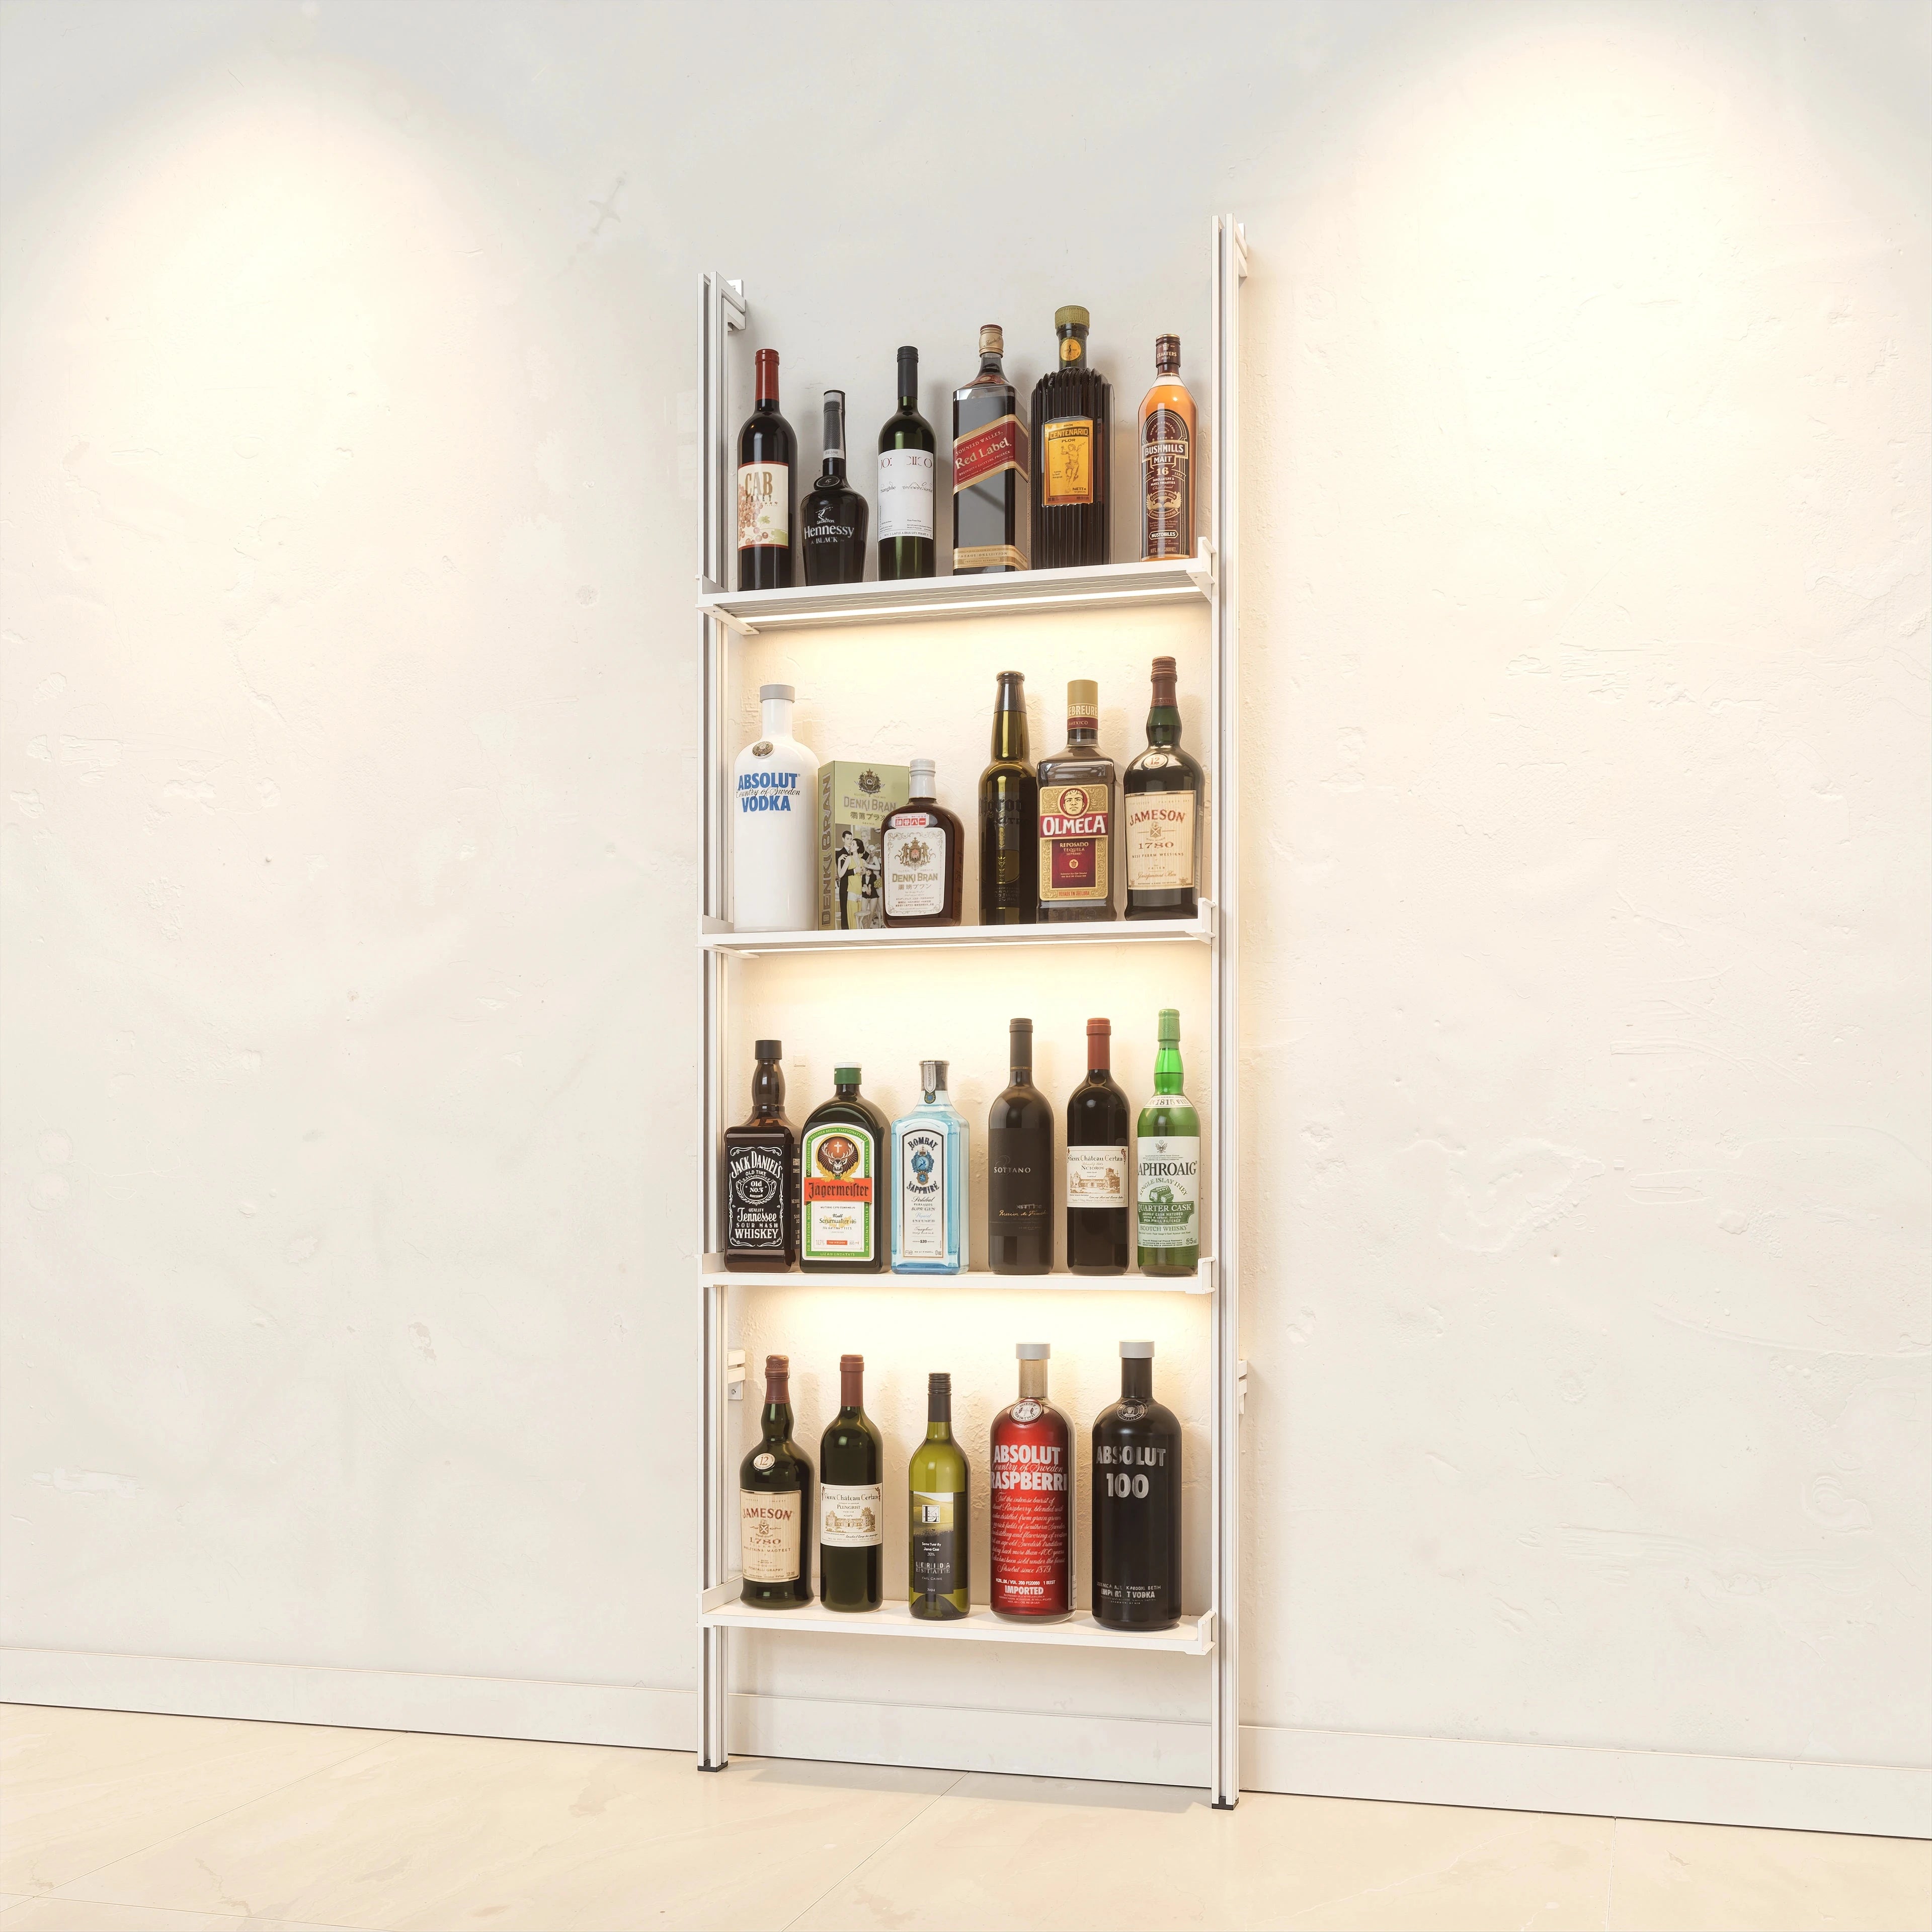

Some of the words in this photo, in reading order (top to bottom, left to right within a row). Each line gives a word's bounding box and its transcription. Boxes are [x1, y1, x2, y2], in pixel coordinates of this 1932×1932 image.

[1050, 428, 1089, 439] CENTENARIO
[1145, 444, 1184, 456] BUSHMILLS
[955, 452, 978, 469] Red
[1156, 466, 1169, 475] 16
[745, 471, 773, 496] CAB
[804, 525, 854, 539] Hennessy
[1150, 757, 1160, 765] 12
[738, 772, 798, 791] ABSOLUT
[736, 786, 759, 798] Country
[760, 786, 770, 798] of
[770, 785, 800, 796] Sweden
[742, 795, 791, 813] VODKA
[844, 796, 870, 812] DENKI
[871, 798, 897, 813] BRAN
[822, 772, 832, 851] BRAN
[1130, 809, 1185, 826] JAMESON
[1042, 815, 1106, 836] OLMECA
[1138, 841, 1174, 850] 1780
[892, 873, 916, 883] DENKI
[917, 872, 938, 881] BRAN
[822, 852, 832, 925] DENKI
[907, 1137, 938, 1151] BOMBAY
[730, 1154, 751, 1178] JACK
[1138, 1161, 1196, 1176] APHROAIG
[906, 1180, 939, 1194] SAPPHIRE
[1140, 1179, 1155, 1197] SINGLE
[737, 1207, 777, 1222] Tennessee
[1138, 1204, 1169, 1213] QUARTER
[735, 1228, 779, 1239] WHISKEY
[759, 1456, 768, 1466] 12
[994, 1444, 1061, 1465] ABSOLUT
[1096, 1445, 1166, 1467] ABSOLUT
[992, 1461, 1018, 1473] Country
[1018, 1462, 1030, 1473] of
[1030, 1460, 1063, 1473] Sweden
[991, 1471, 1067, 1491] RASPBERRI
[1106, 1473, 1149, 1499] 100
[1048, 1497, 1056, 1506] of
[743, 1508, 792, 1522] JAMESON
[1018, 1514, 1031, 1523] from
[1031, 1515, 1047, 1524] grain
[1018, 1523, 1025, 1532] of
[1022, 1532, 1048, 1541] flavoring
[1048, 1532, 1056, 1540] of
[997, 1564, 1020, 1573] Absolut
[1005, 1585, 1044, 1595] IMPORTED
